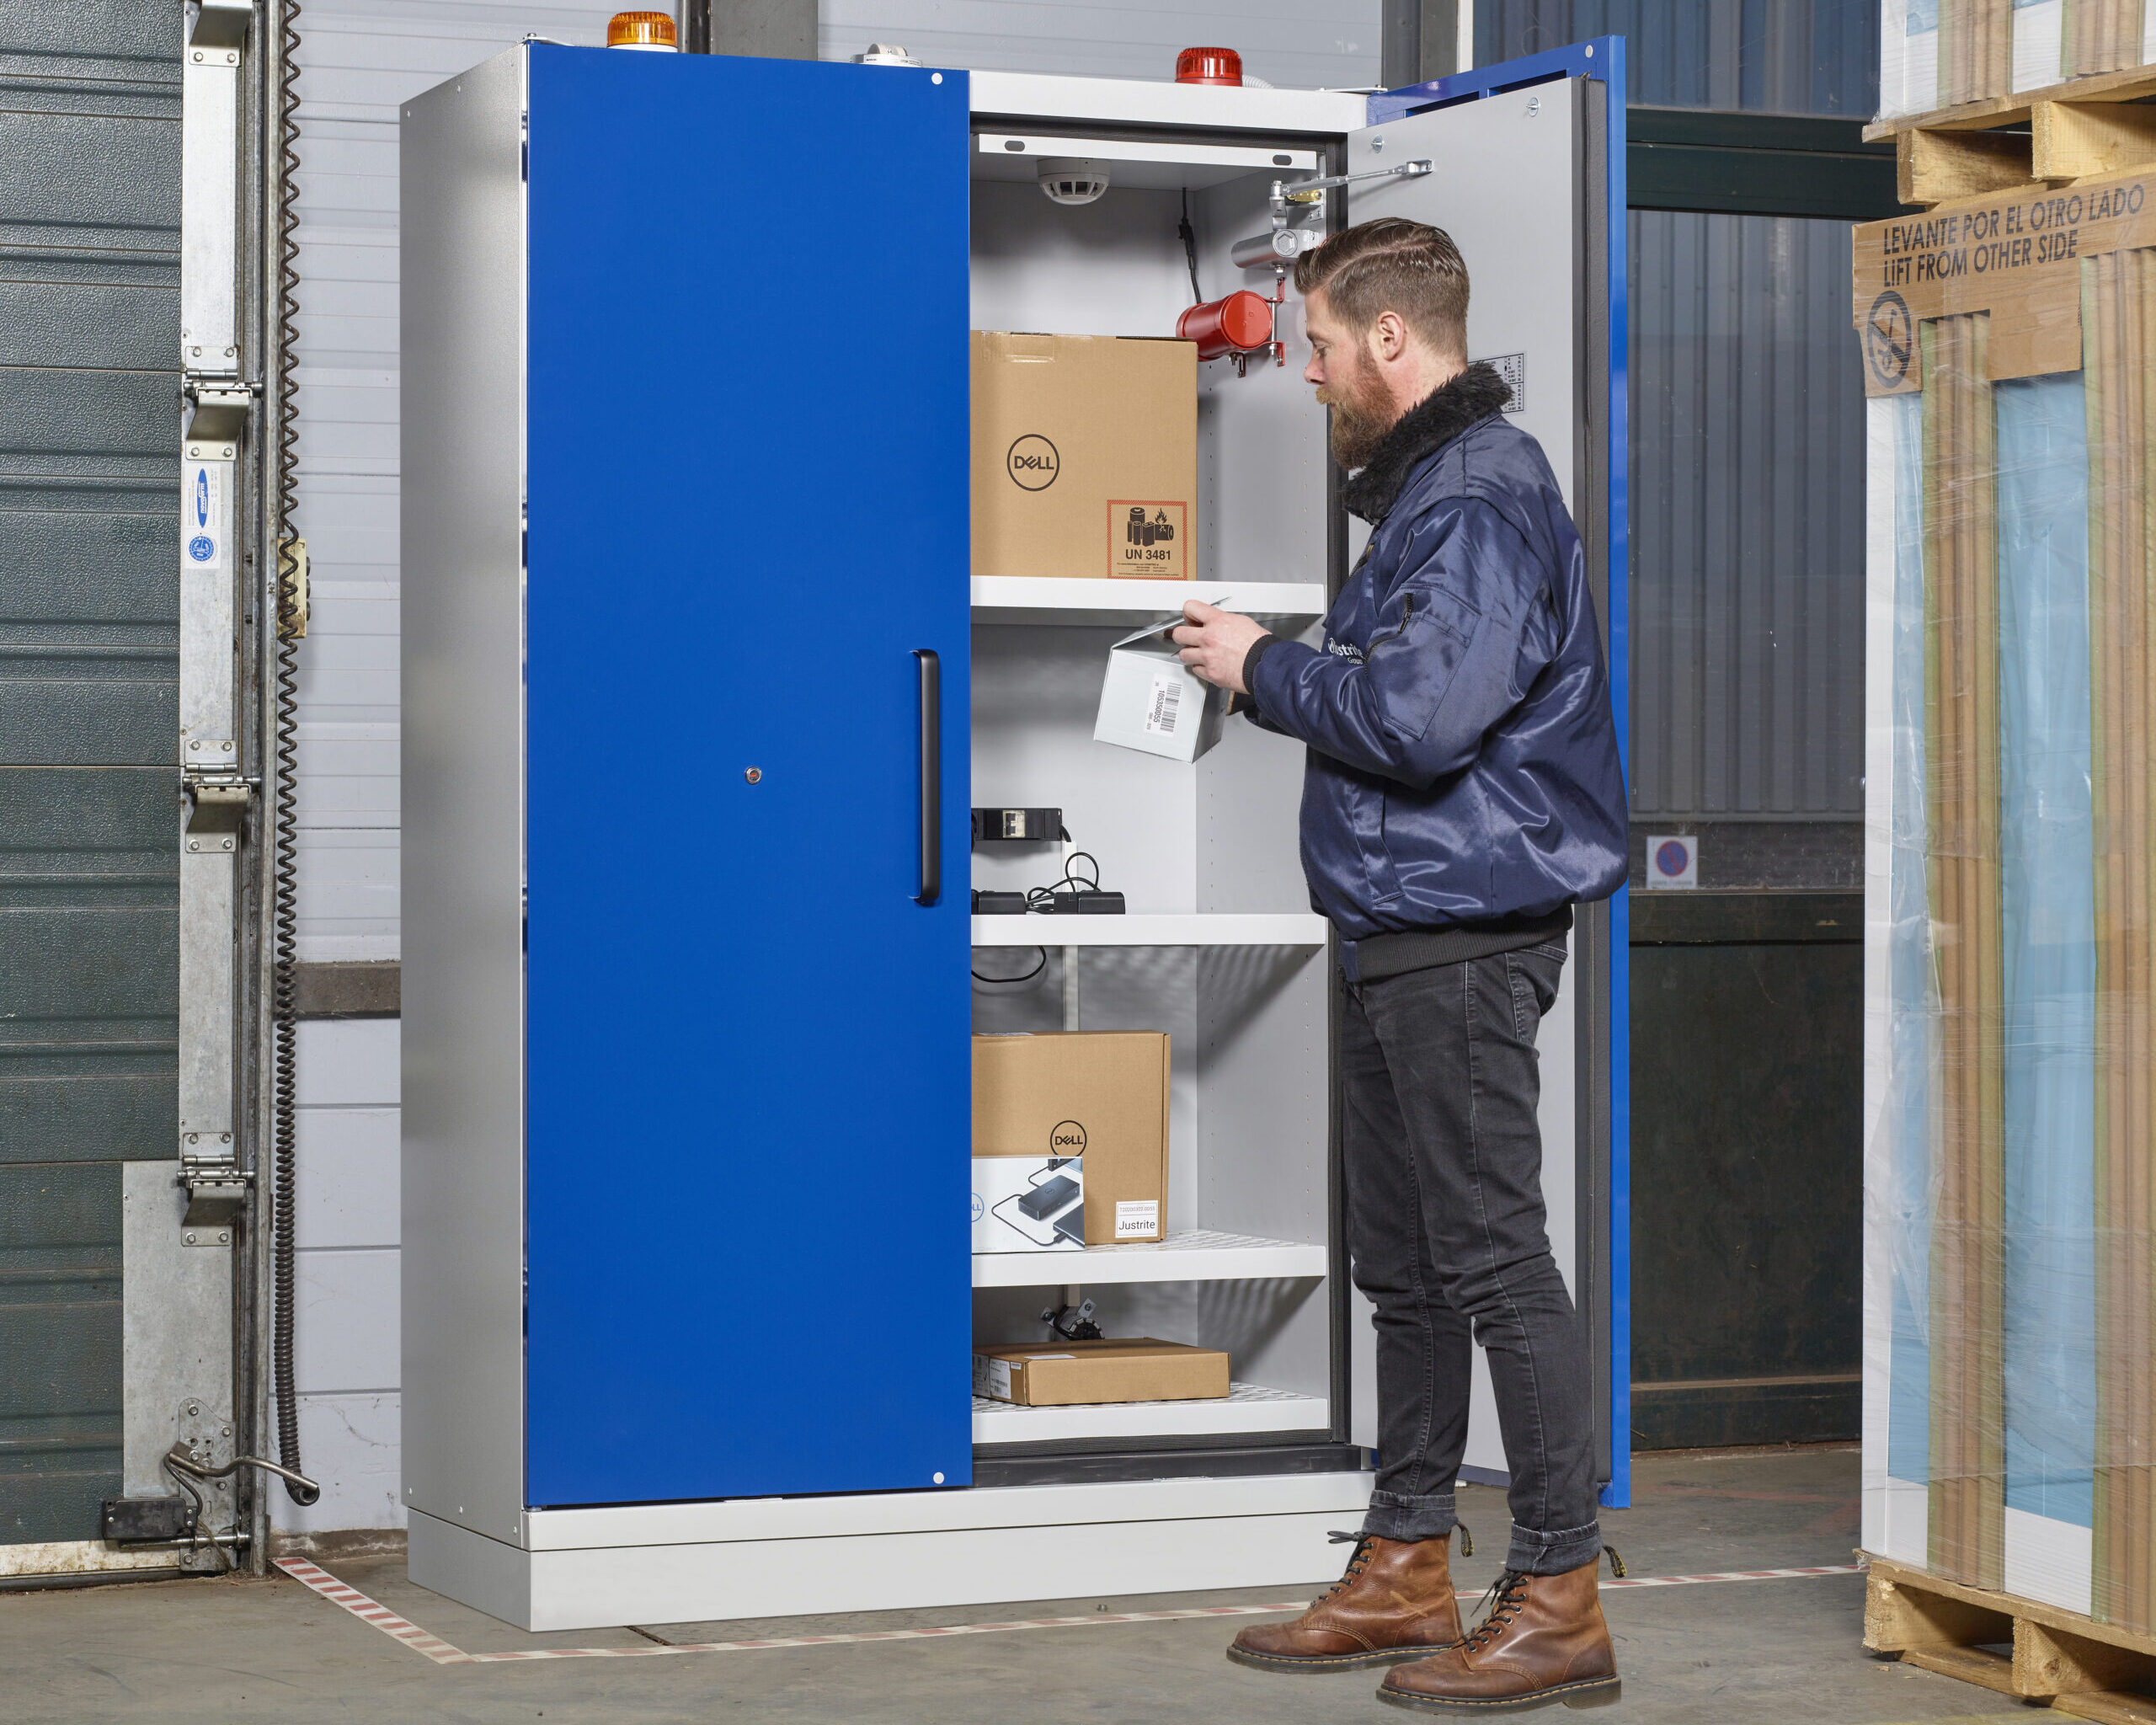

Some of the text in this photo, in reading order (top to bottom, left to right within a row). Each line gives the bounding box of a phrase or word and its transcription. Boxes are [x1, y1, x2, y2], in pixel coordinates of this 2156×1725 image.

[1883, 184, 2145, 255] LEVANTE POR EL OTRO LADO
[1883, 228, 2079, 287] LIFT FROM OTHER SIDE
[1014, 455, 1054, 470] DELL
[1125, 549, 1171, 560] UN 3481
[1054, 1135, 1083, 1146] DELL
[1118, 1220, 1155, 1231] Justrite
